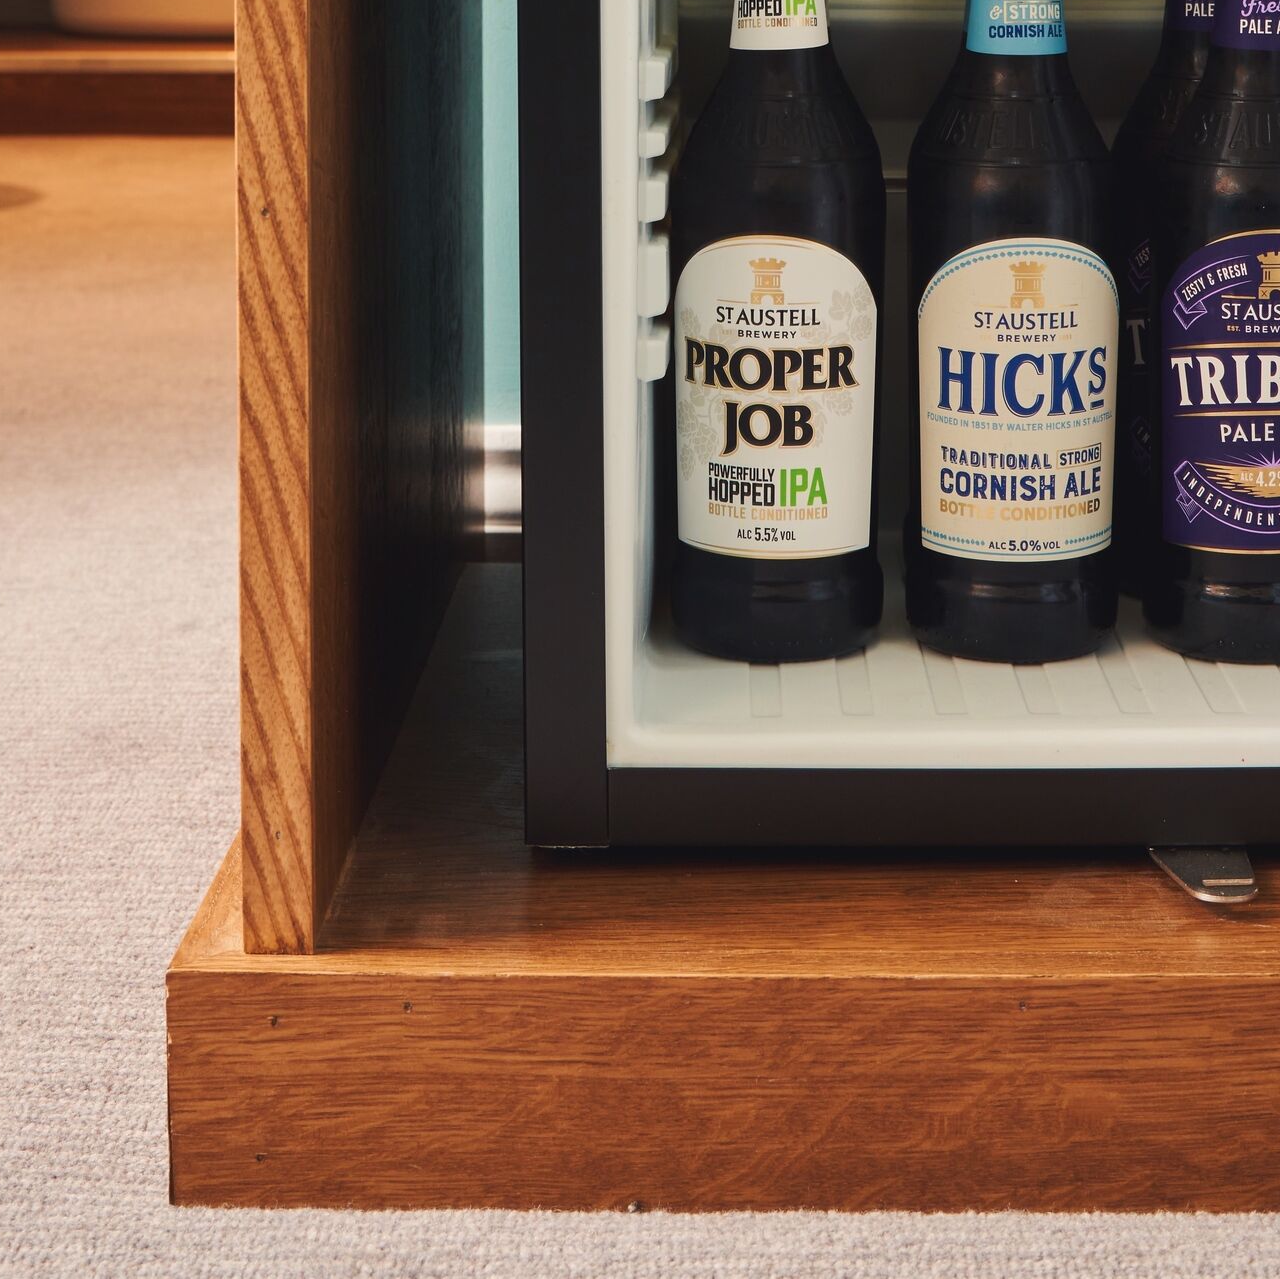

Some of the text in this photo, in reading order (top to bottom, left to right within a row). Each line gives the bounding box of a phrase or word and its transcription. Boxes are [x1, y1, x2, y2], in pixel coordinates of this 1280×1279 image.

[989, 4, 1060, 20] & STRONG
[1185, 3, 1215, 17] PALE
[737, 17, 818, 29] BOTTLE CONDINED
[988, 24, 1063, 39] CORNISH ALE
[1240, 19, 1273, 34] PALE
[1181, 262, 1248, 302] ZESTY & FRESH
[735, 307, 821, 327] AUSTELL
[995, 310, 1078, 330] AUSTELL
[737, 329, 797, 339] BREWERY
[997, 333, 1057, 343] BREWERY
[684, 336, 860, 391] PROPER
[937, 345, 1107, 418] HICKS
[720, 401, 815, 457] JOB
[927, 410, 1113, 432] FOUNDED IN 1851 BY WALTER HICKS IN ST AUSTELL
[1220, 423, 1275, 443] PALE
[940, 445, 1100, 470] TRADITIONAL STRONG
[708, 461, 775, 482] POWERFULLY
[1240, 472, 1254, 481] ALC
[708, 467, 828, 507] HOPPED IPA
[940, 466, 1102, 501] CORNISH ALE
[708, 502, 828, 521] BOTTLE CONDITIONED
[999, 498, 1101, 522] CONDITIONED
[736, 527, 797, 542] ALC 5.5% VOL
[988, 539, 1061, 552] ALC 5.0% VOL
